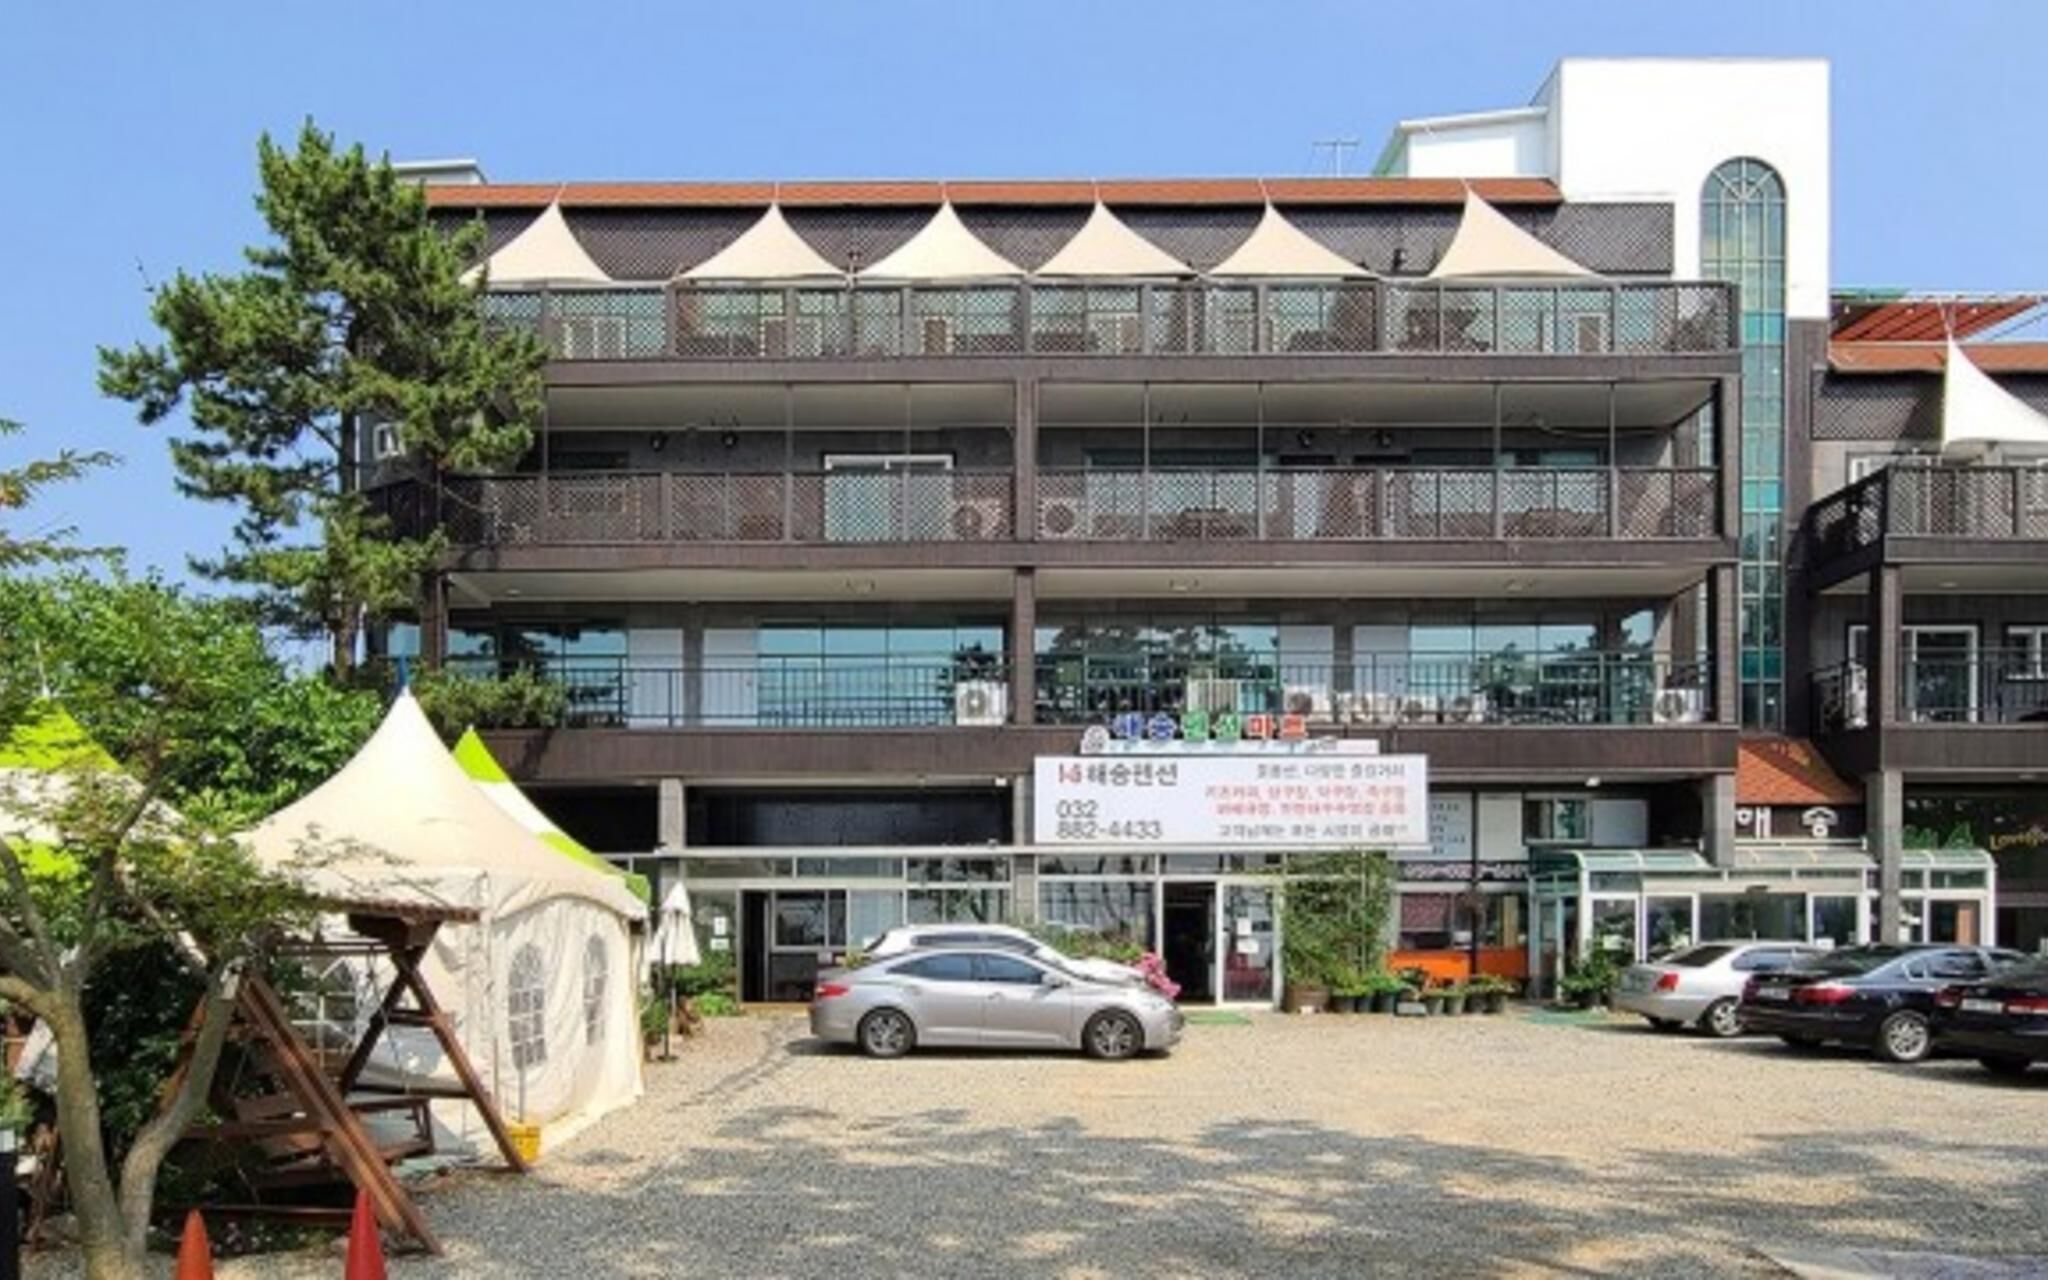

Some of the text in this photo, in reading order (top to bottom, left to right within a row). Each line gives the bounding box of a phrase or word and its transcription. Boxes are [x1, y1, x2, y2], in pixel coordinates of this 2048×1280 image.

[1087, 763, 1178, 787] 해송펜션
[1056, 799, 1098, 819] 032
[1056, 820, 1162, 839] 882-4433
